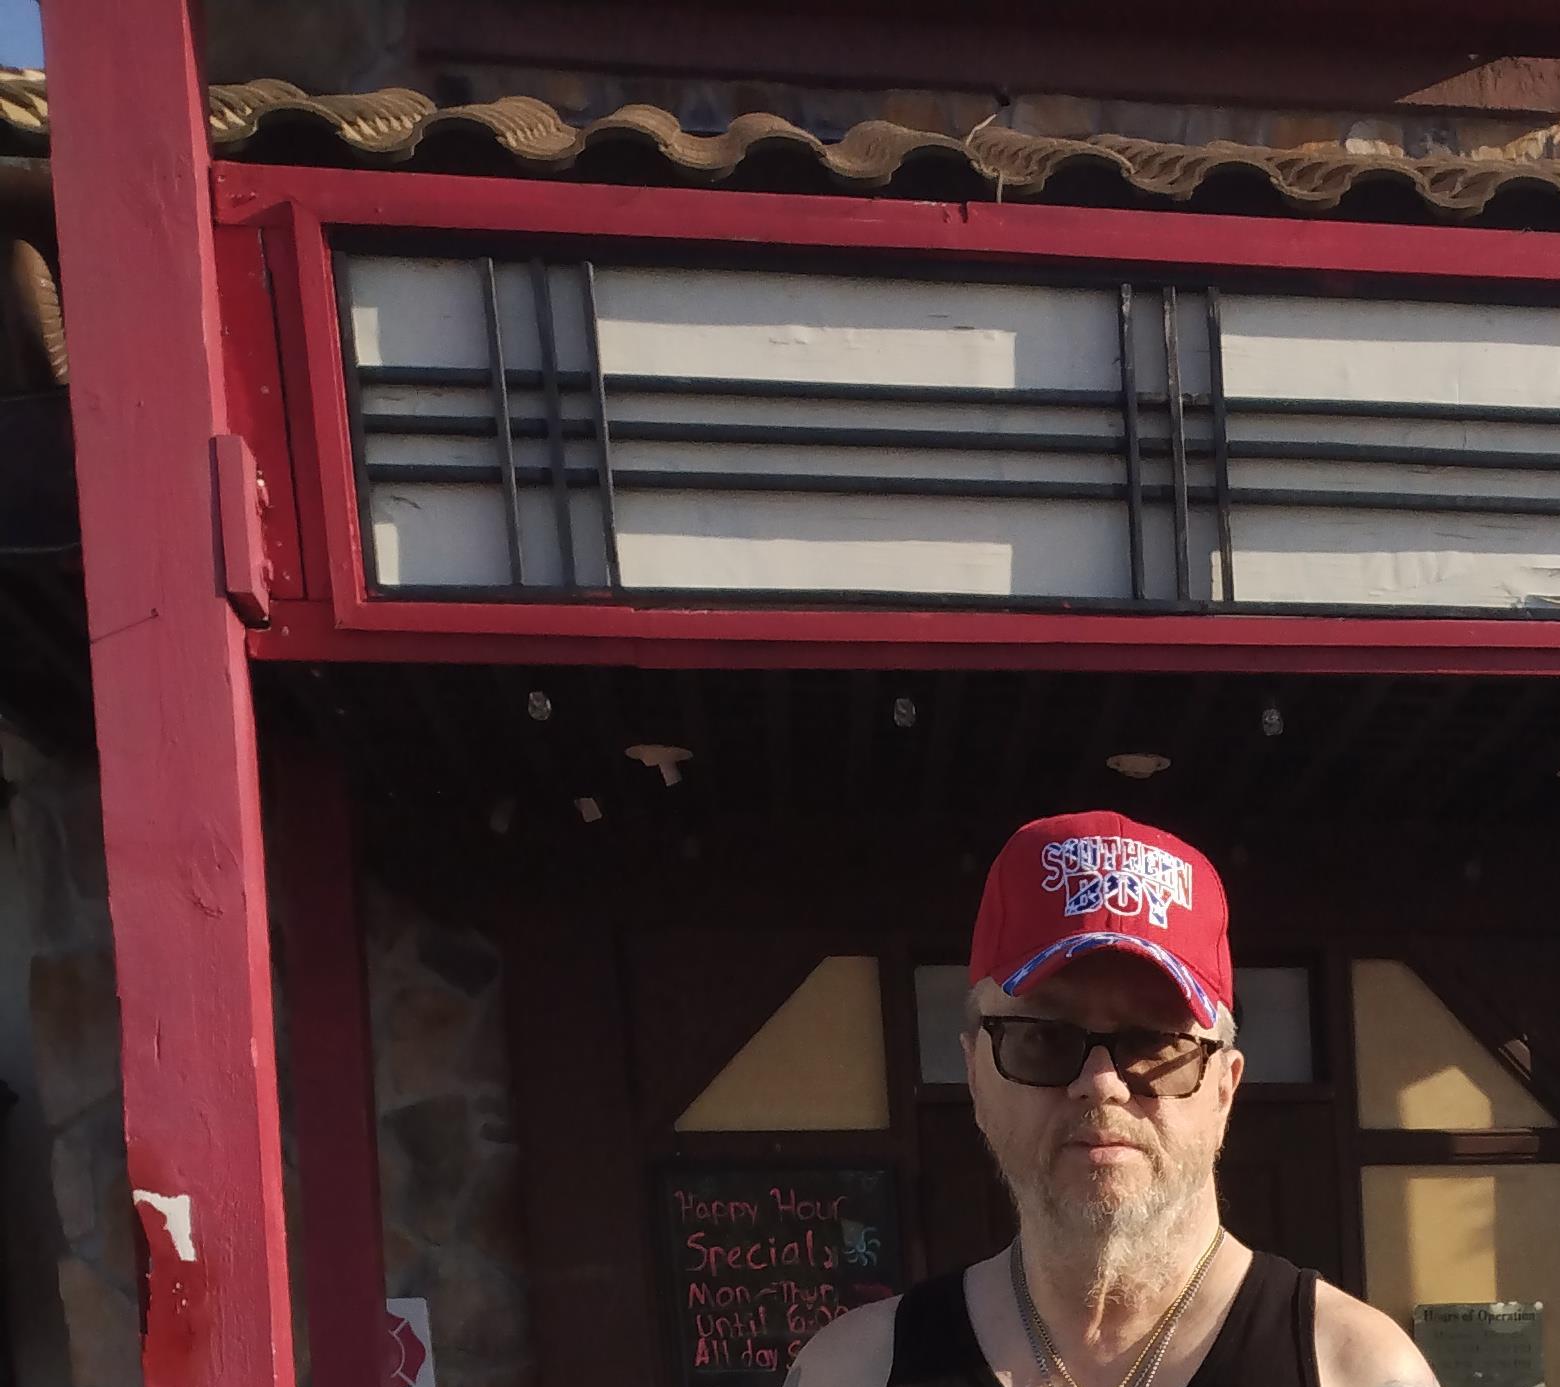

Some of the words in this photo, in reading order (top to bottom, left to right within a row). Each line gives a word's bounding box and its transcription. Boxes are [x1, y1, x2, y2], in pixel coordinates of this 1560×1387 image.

[1041, 835, 1193, 911] SOUTHERN
[1064, 870, 1175, 929] BOY
[674, 1190, 758, 1225] Happy
[770, 1188, 847, 1223] Hour
[685, 1231, 836, 1277] Specials
[696, 1305, 768, 1338] Until
[1423, 1309, 1459, 1322] Hours
[1462, 1308, 1475, 1321] of
[1478, 1309, 1536, 1325] Operation
[694, 1337, 730, 1367] All
[741, 1338, 778, 1371] day
